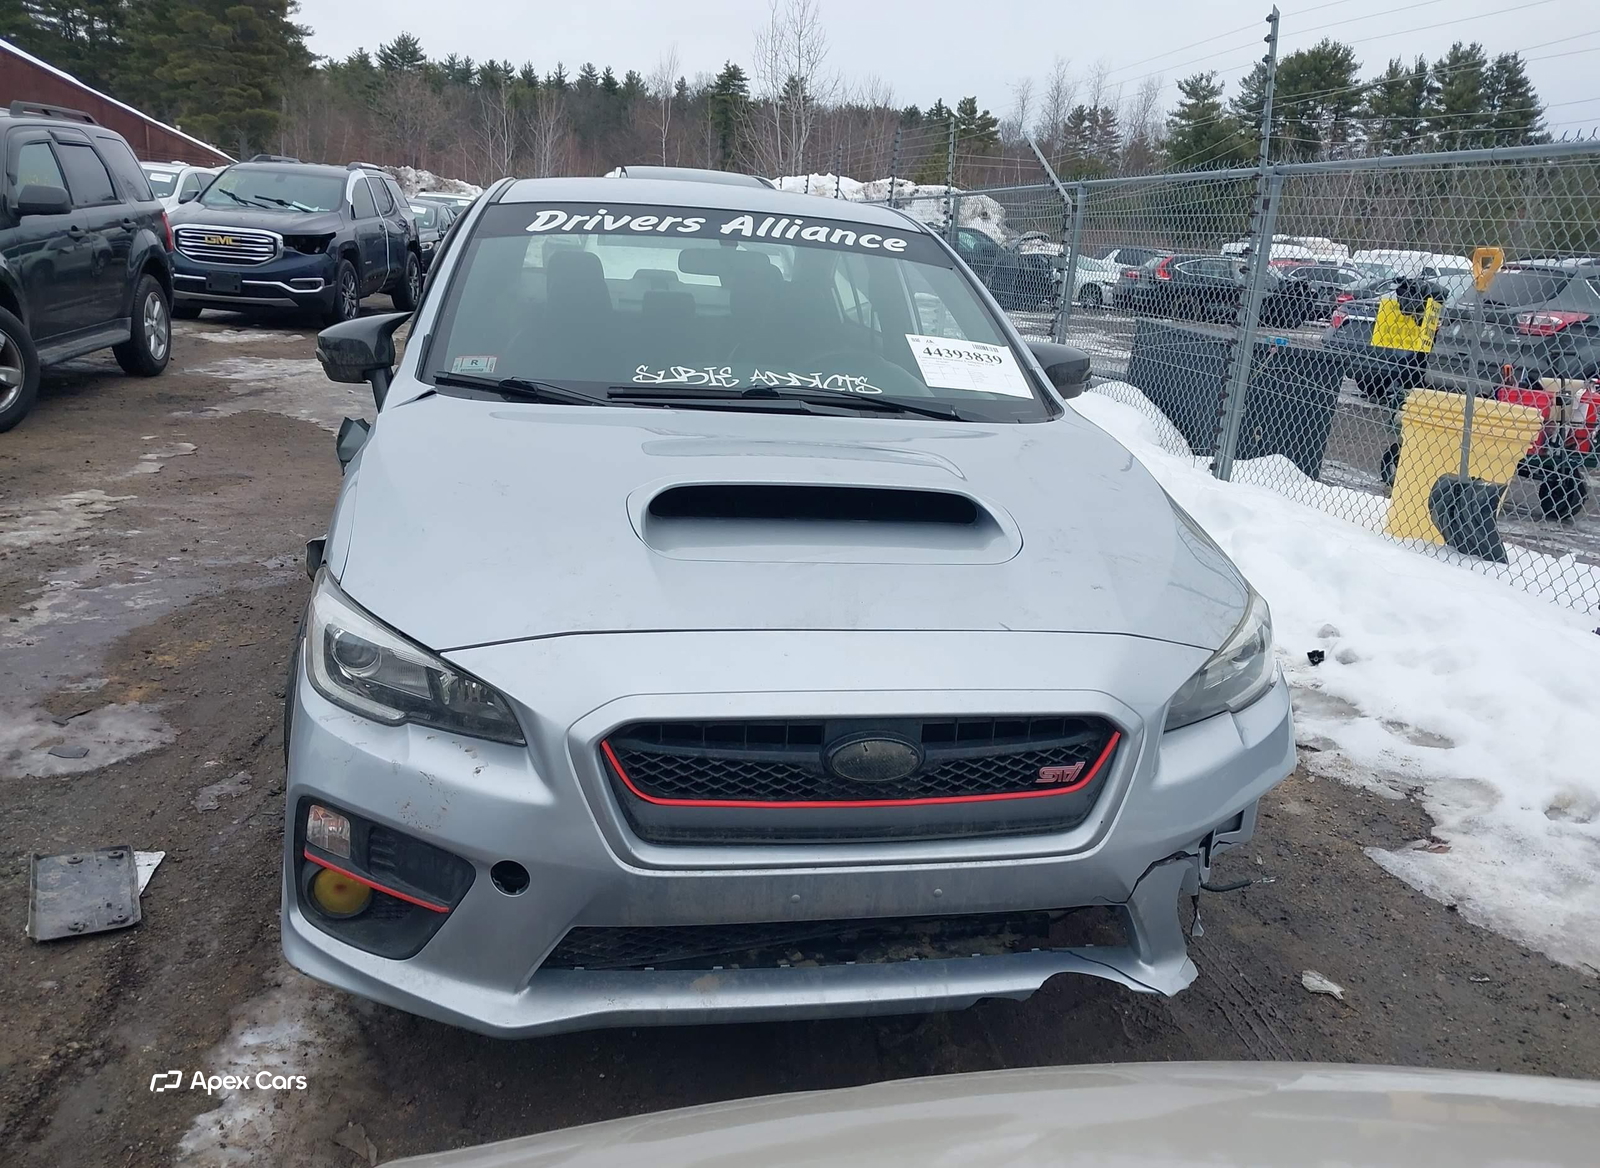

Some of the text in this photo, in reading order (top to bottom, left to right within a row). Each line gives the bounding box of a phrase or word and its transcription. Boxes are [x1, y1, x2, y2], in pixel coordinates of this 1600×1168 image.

[204, 234, 242, 246] GMC
[525, 208, 908, 252] Drivers Alliance
[922, 346, 1003, 365] 44393839
[632, 364, 883, 394] SUBIE ADDICTS
